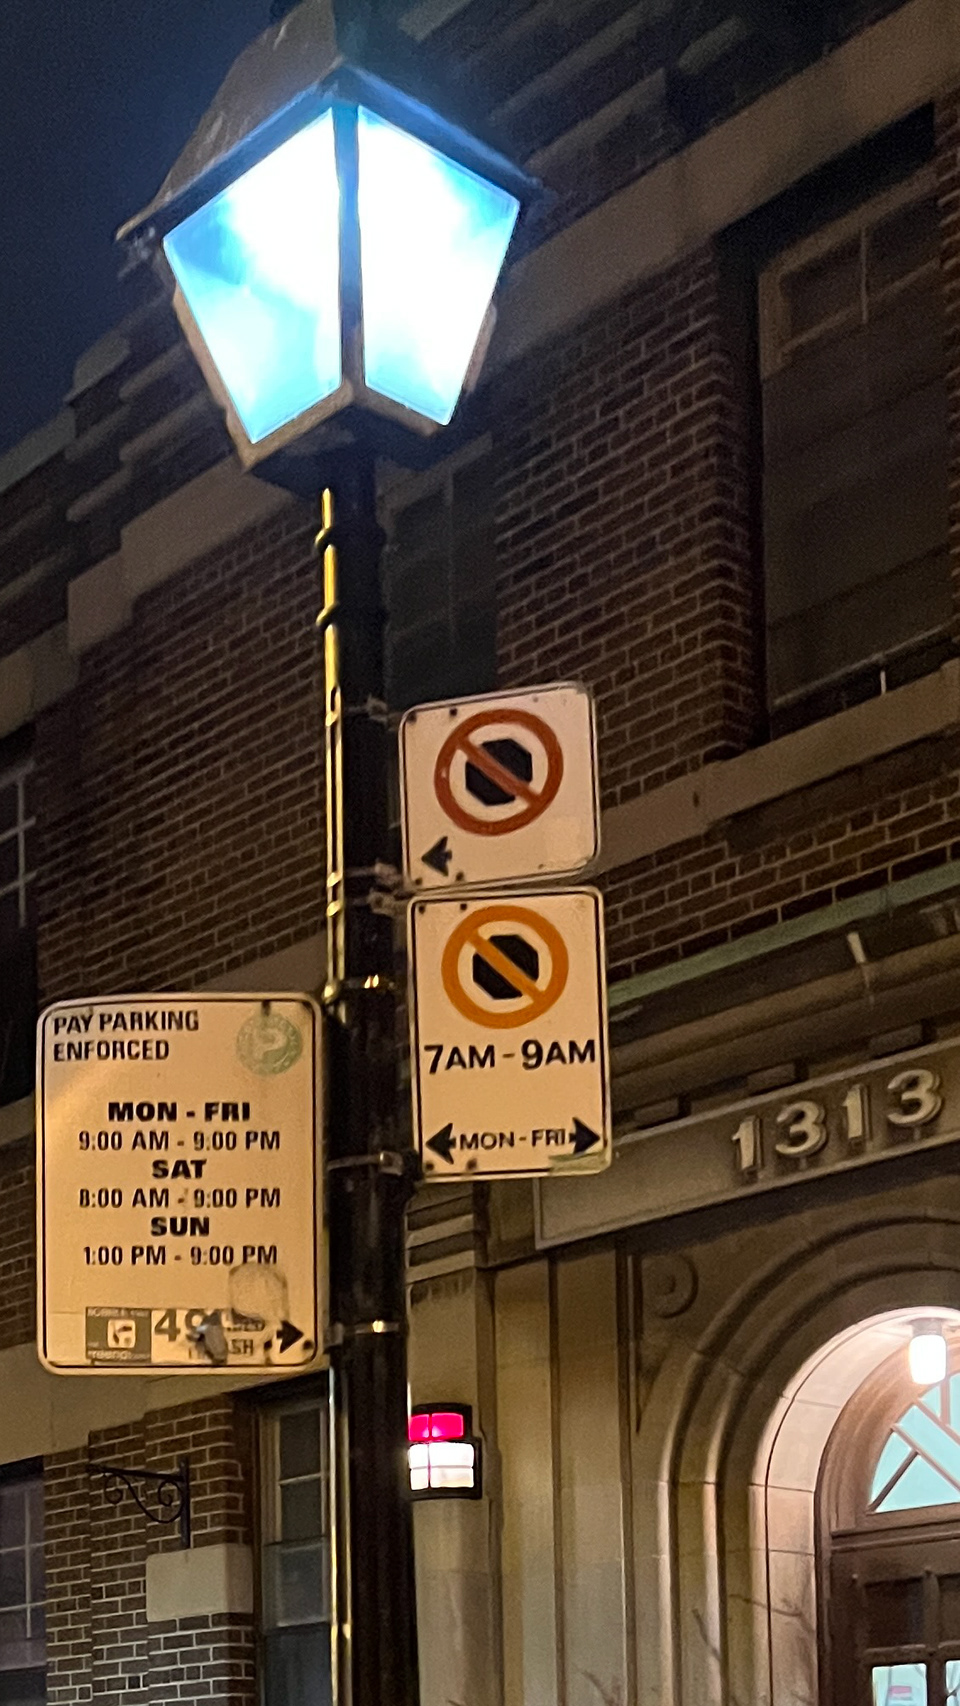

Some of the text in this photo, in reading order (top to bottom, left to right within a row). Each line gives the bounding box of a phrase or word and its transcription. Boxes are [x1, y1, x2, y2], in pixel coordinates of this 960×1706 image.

[53, 1010, 199, 1034] PAY PARKING
[53, 1039, 170, 1061] ENFORCED
[108, 1102, 177, 1122] MON
[204, 1102, 250, 1122] FRI
[732, 1069, 942, 1171] 1313
[79, 1130, 122, 1151] 9:00
[132, 1130, 169, 1151] AM
[193, 1130, 237, 1151] 9:00
[245, 1130, 280, 1151] PM
[152, 1159, 207, 1179] SAT
[79, 1187, 122, 1208] 8:00
[132, 1187, 169, 1208] AM
[245, 1187, 280, 1208] PM
[151, 1216, 209, 1236] SUN
[83, 1246, 123, 1266] 1:00
[131, 1246, 166, 1266] PM
[190, 1245, 234, 1266] 9:00
[242, 1245, 277, 1266] PM
